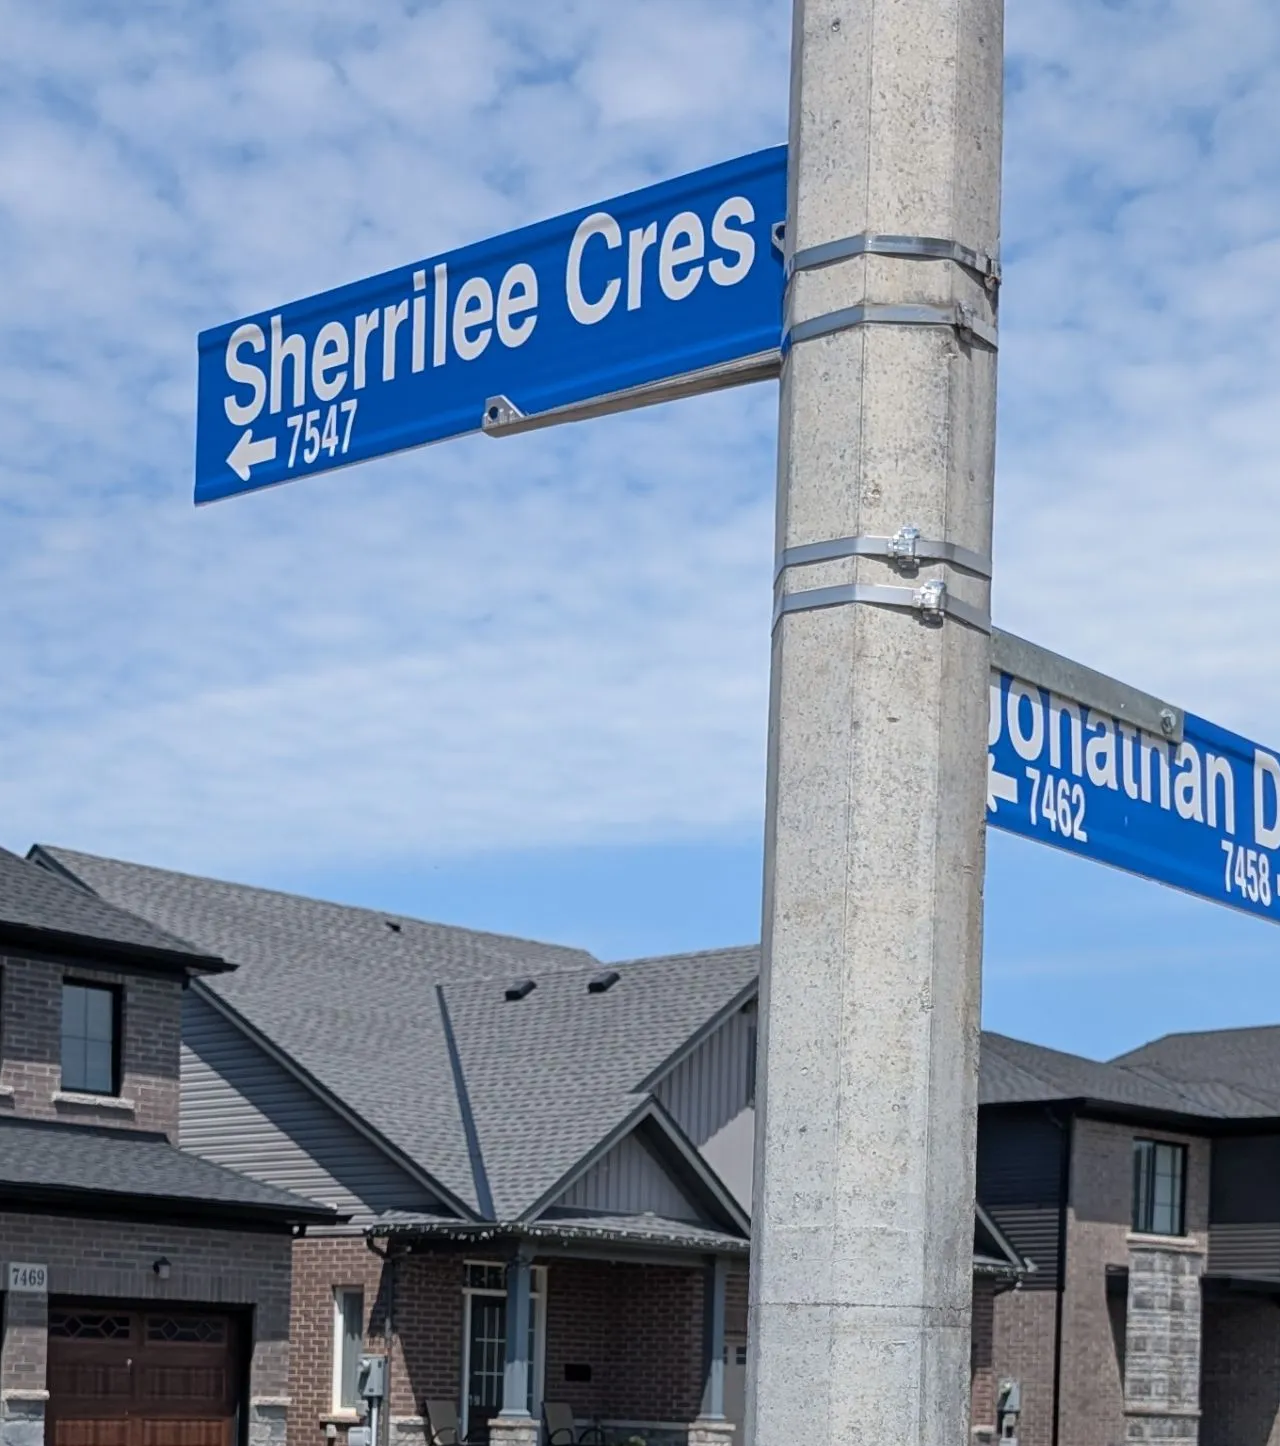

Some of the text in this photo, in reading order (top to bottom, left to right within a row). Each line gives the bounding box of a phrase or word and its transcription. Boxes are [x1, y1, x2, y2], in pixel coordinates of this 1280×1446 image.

[224, 196, 756, 426] Sherrilee Cres
[286, 399, 358, 468] 7547
[1025, 766, 1088, 842] 7462
[1221, 840, 1271, 906] 7458
[12, 1267, 45, 1286] 7469
